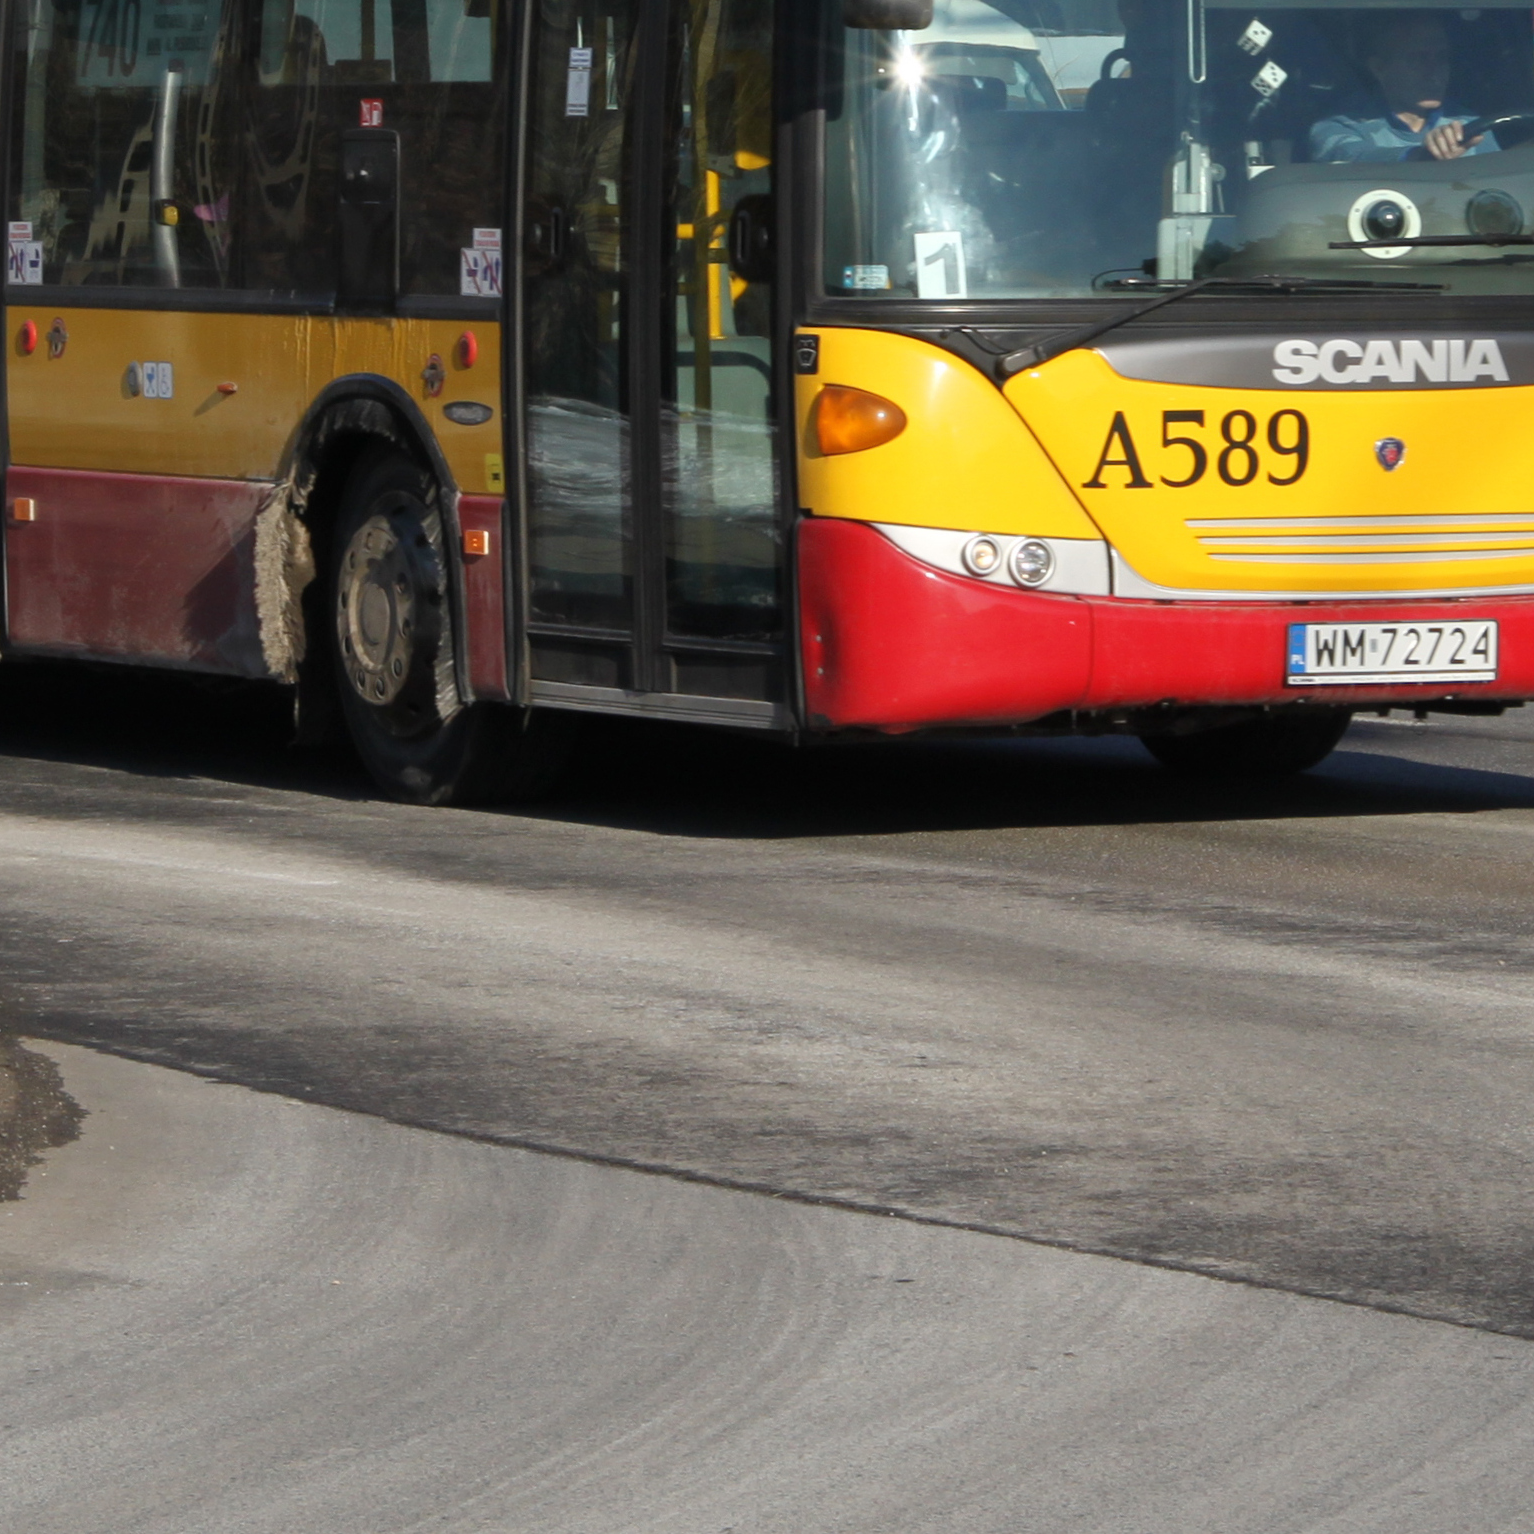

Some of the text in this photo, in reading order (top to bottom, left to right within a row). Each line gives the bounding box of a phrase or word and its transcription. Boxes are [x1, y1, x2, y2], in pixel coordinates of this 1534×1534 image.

[924, 242, 960, 295] 1
[1272, 339, 1510, 385] SCANIA
[1082, 408, 1310, 490] A589
[1291, 654, 1305, 665] PL
[1315, 626, 1490, 668] WM 72724
